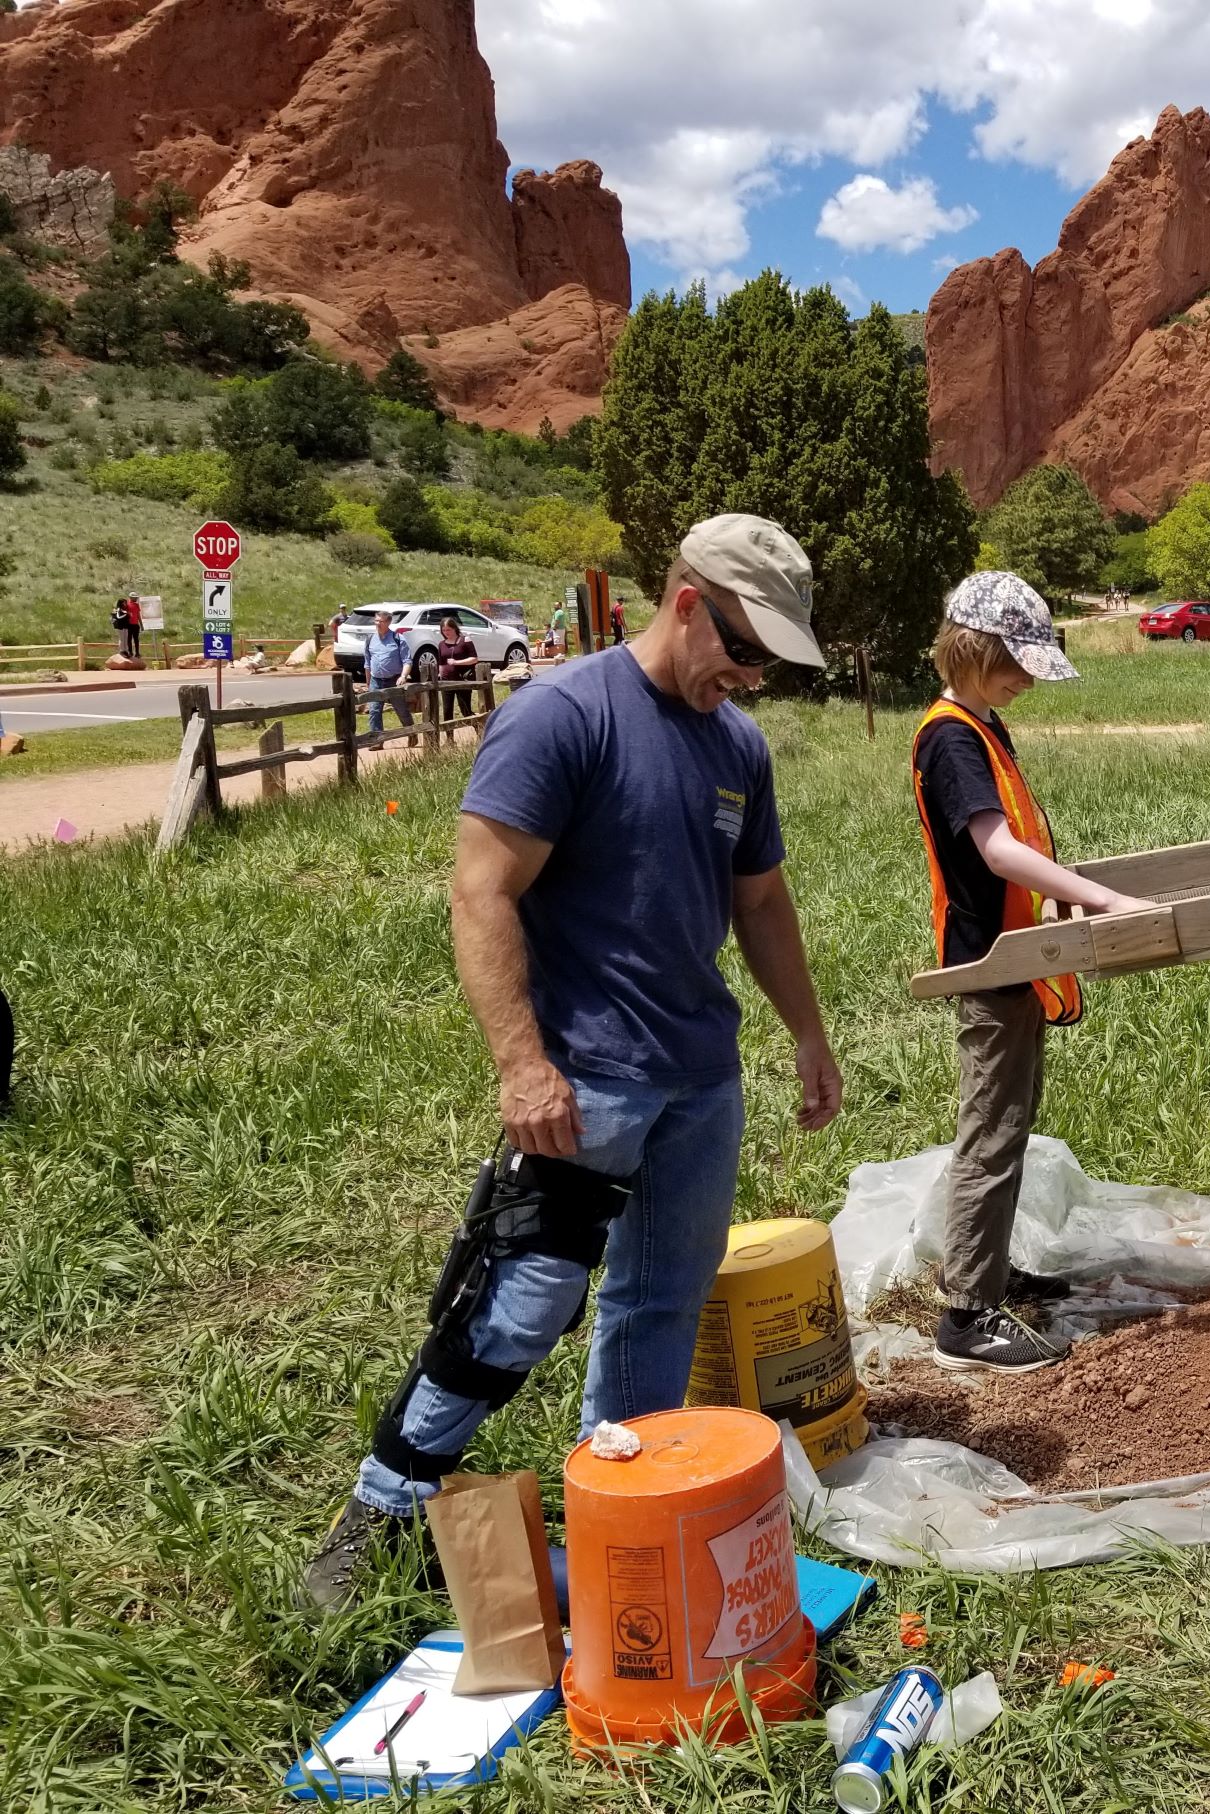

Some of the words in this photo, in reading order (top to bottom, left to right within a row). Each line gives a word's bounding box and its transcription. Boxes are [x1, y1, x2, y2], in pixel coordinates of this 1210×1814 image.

[197, 536, 238, 556] STOP
[208, 608, 227, 616] ONLY
[775, 1362, 826, 1388] CEMENT
[800, 1366, 853, 1409] UIKRETE
[617, 1655, 653, 1666] AVISO
[875, 1673, 935, 1758] NOS
